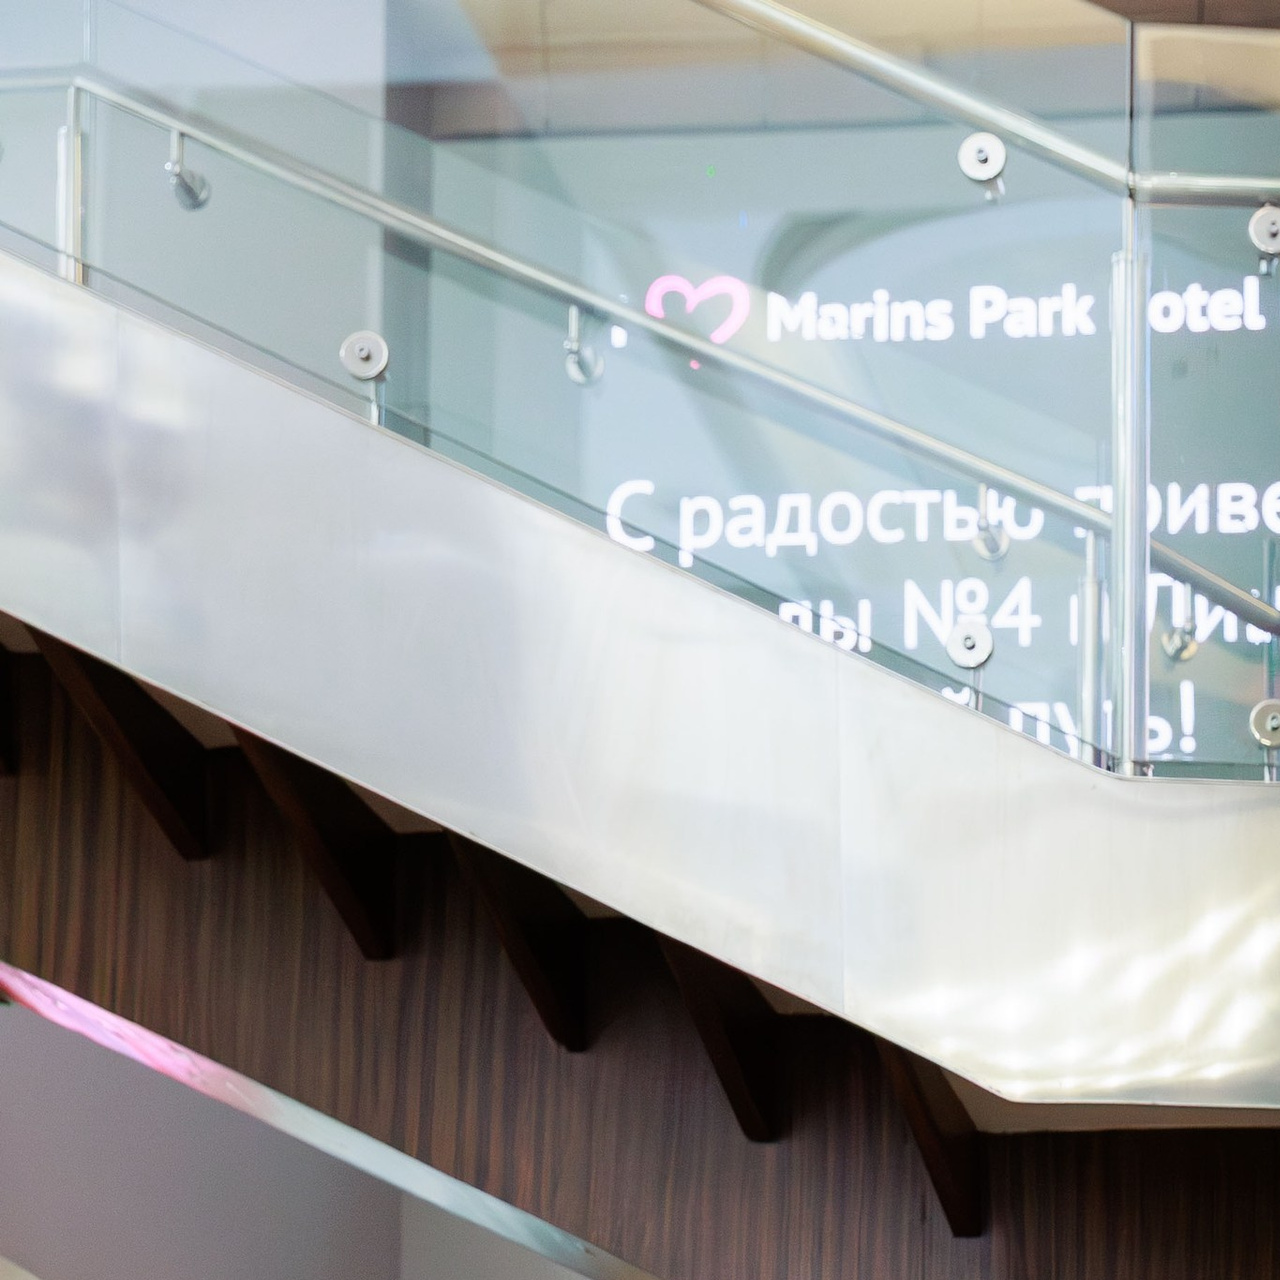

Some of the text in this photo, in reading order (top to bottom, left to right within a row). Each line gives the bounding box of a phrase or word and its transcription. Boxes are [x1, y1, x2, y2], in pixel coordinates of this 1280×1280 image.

[767, 289, 953, 343] Marins
[969, 283, 1096, 338] Park
[1110, 275, 1266, 334] otel
[606, 479, 655, 552] С
[904, 576, 1041, 650] №4
